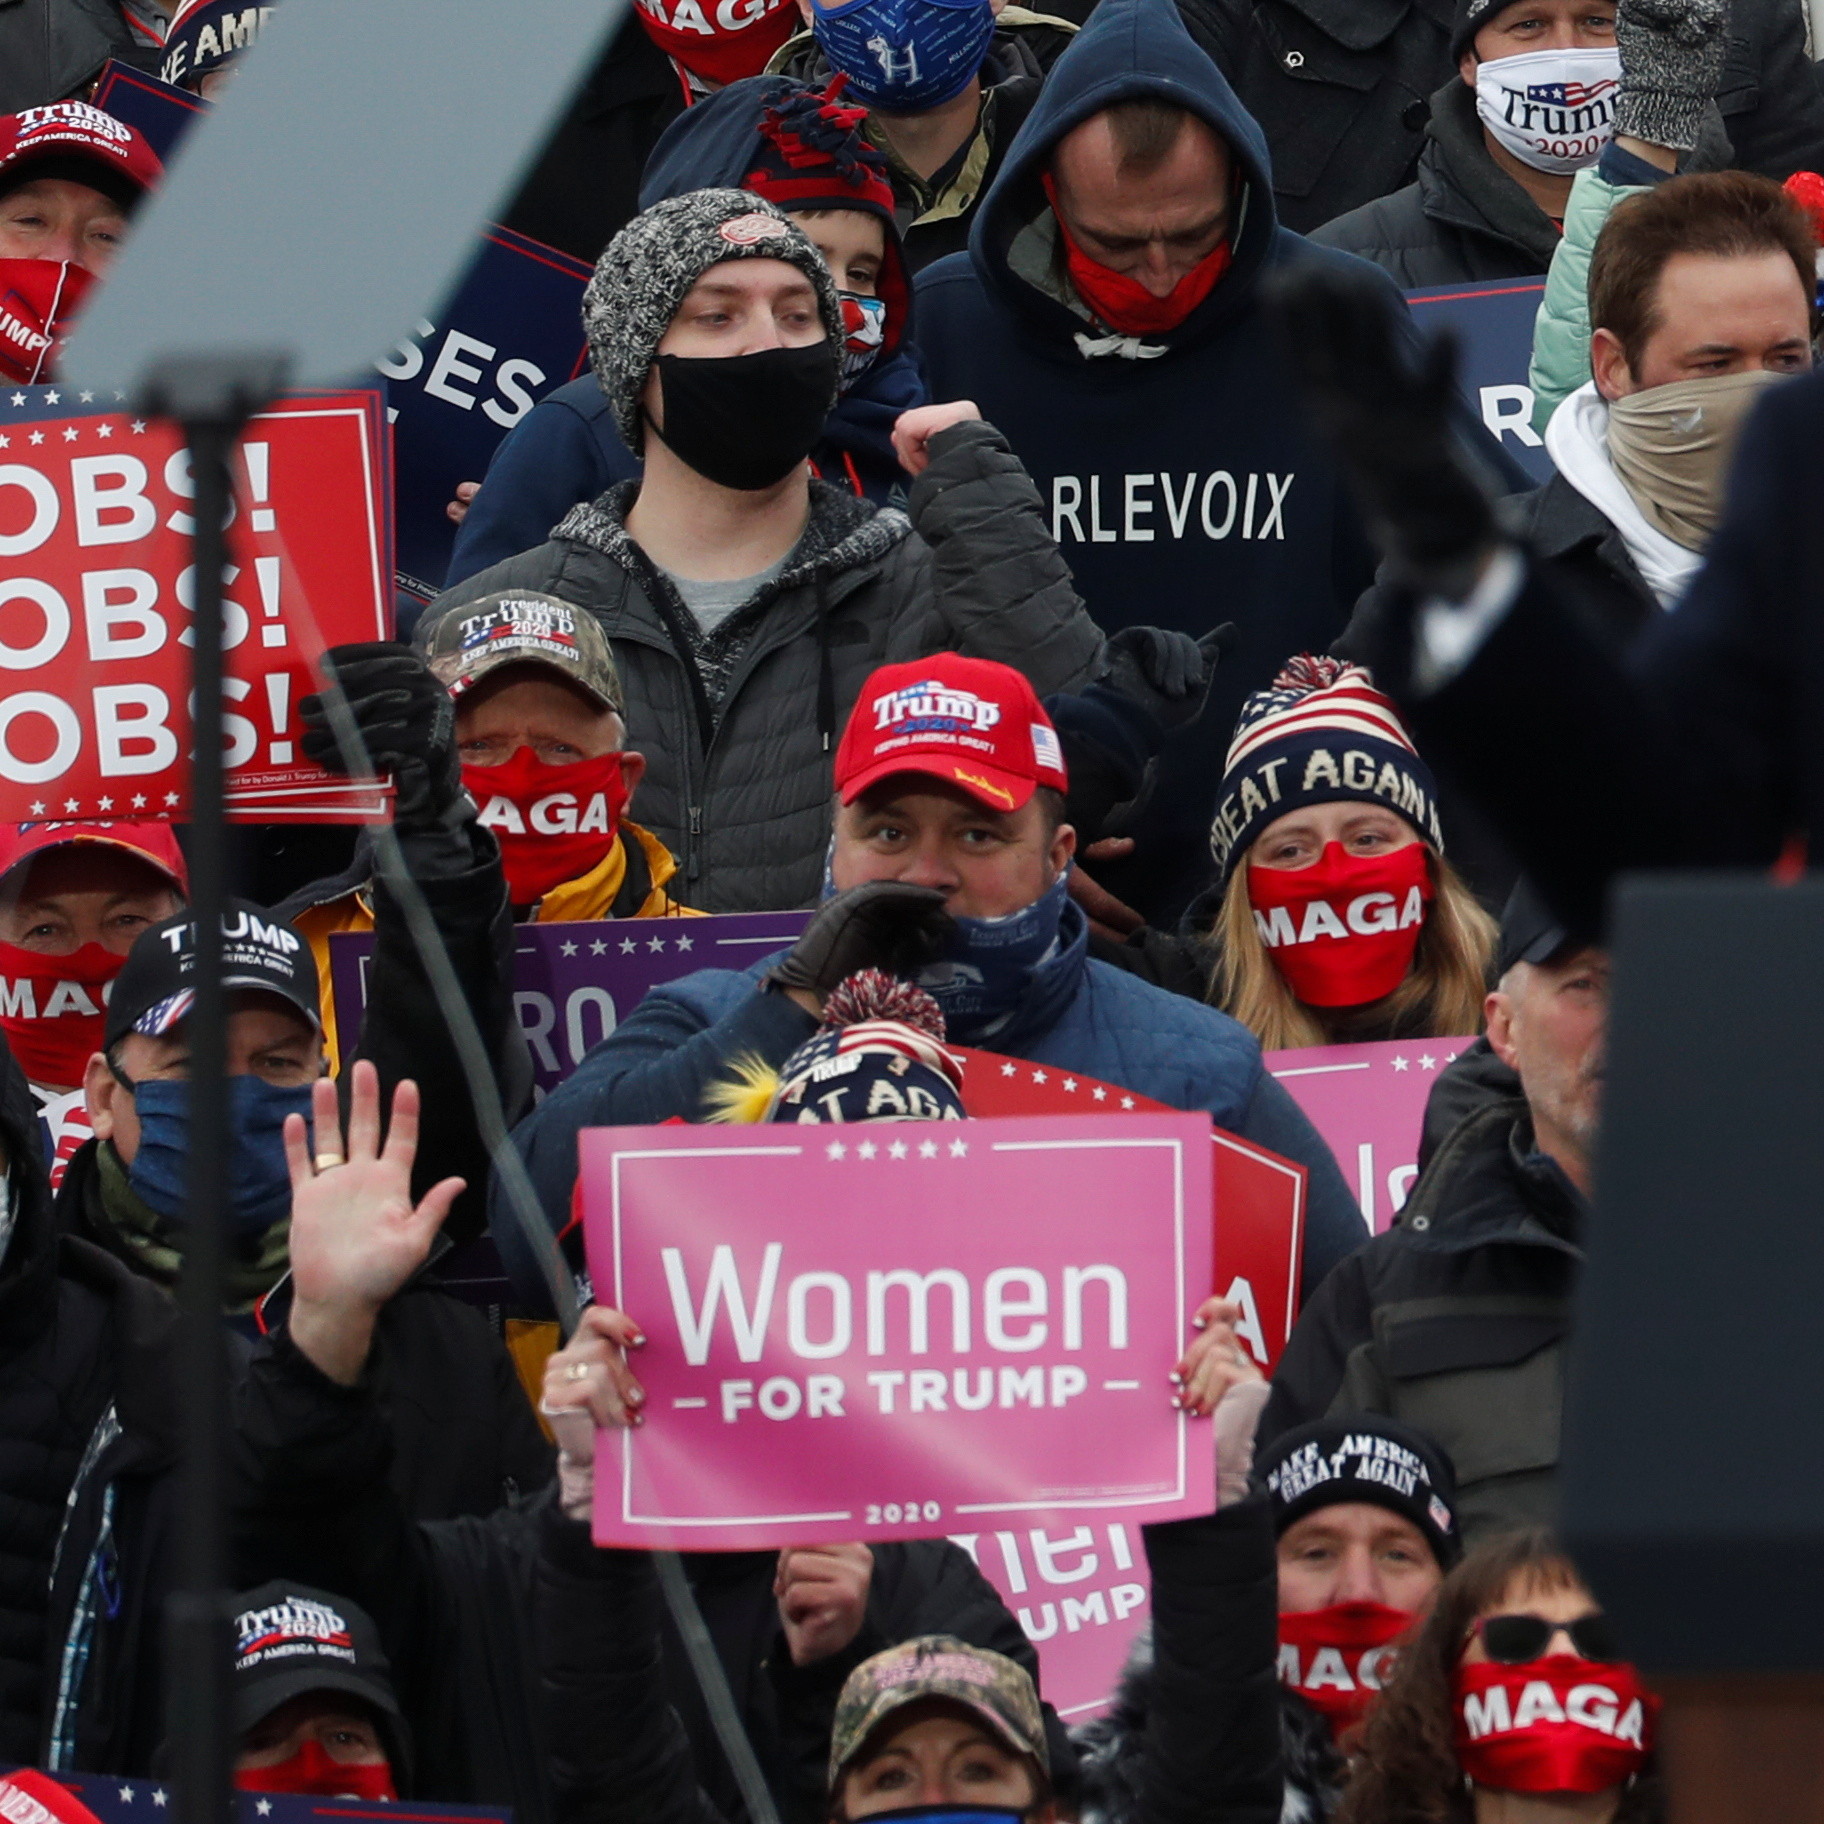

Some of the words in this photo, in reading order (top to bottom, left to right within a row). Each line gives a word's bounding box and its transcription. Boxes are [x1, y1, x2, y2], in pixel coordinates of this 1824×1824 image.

[16, 104, 132, 141] Trump
[68, 117, 113, 137] 2020
[1537, 136, 1604, 160] 2020
[1049, 470, 1294, 543] RLEVOIX
[459, 601, 575, 635] Trump
[499, 599, 571, 620] President
[511, 620, 553, 636] 2020
[873, 689, 1000, 730] Trump
[662, 1242, 1128, 1368] Women
[720, 1375, 846, 1424] FOR
[867, 1366, 1087, 1415] TRUMP
[865, 1502, 941, 1526] 2020
[235, 1606, 347, 1635] Trump
[281, 1623, 328, 1637] 2020
[266, 1645, 318, 1663] AMERICA
[1463, 1682, 1646, 1750] MAGA
